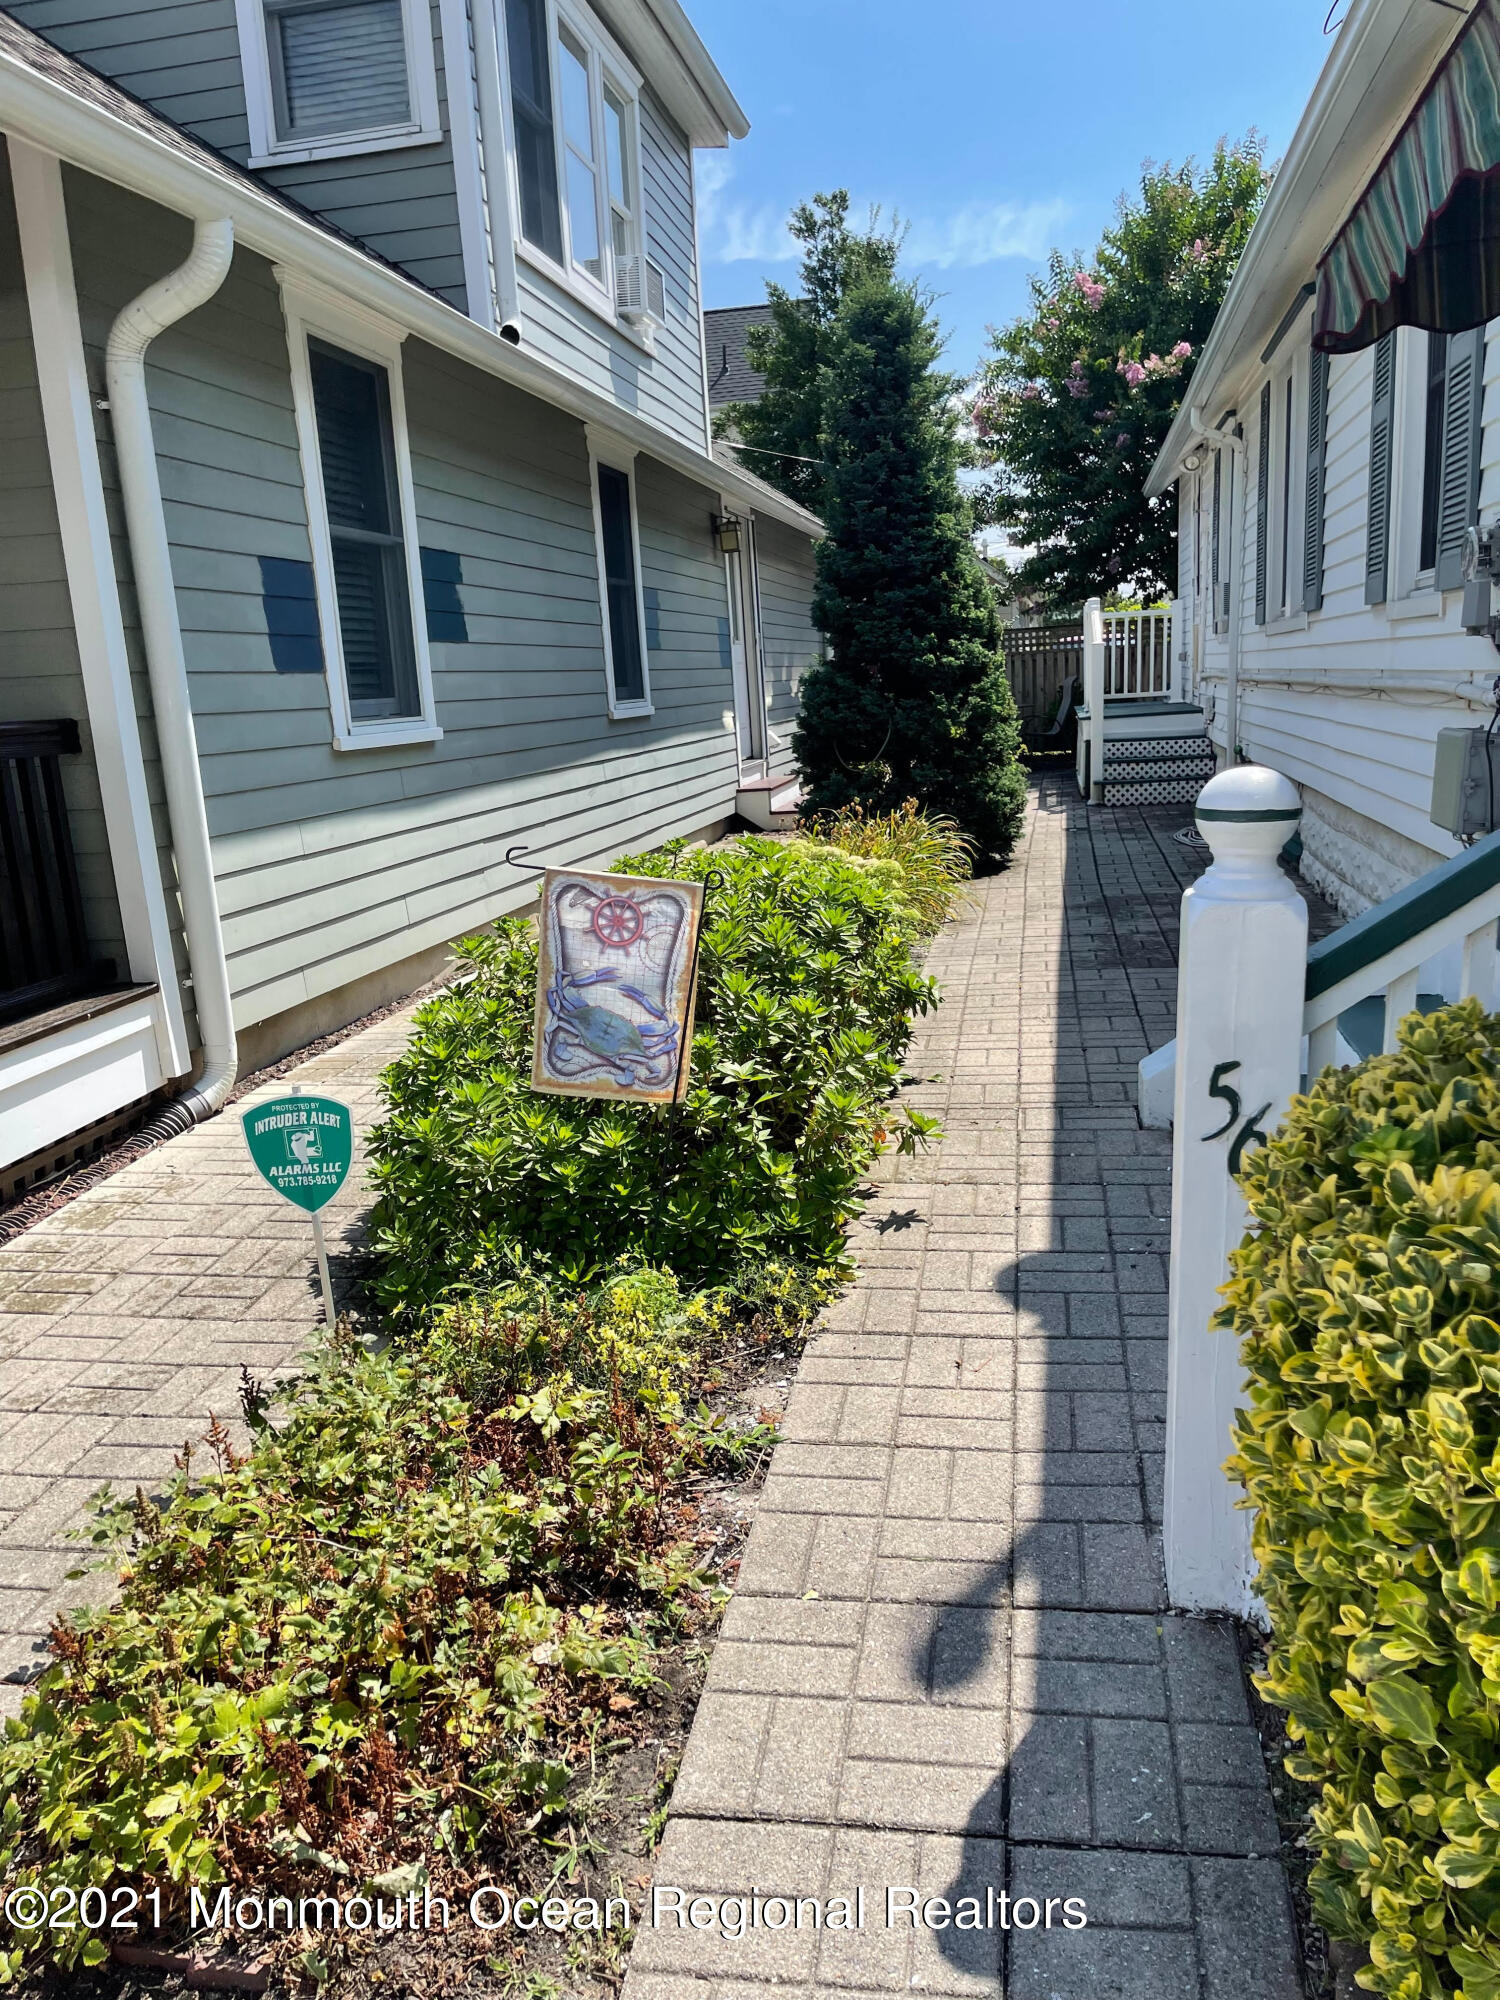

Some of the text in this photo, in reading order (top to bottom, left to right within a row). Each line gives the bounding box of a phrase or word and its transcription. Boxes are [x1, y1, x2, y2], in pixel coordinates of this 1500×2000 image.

[271, 1103, 309, 1112] PROTECTED
[255, 1112, 341, 1136] INTRUDER ALERT
[269, 1162, 342, 1177] ALARMS LLC
